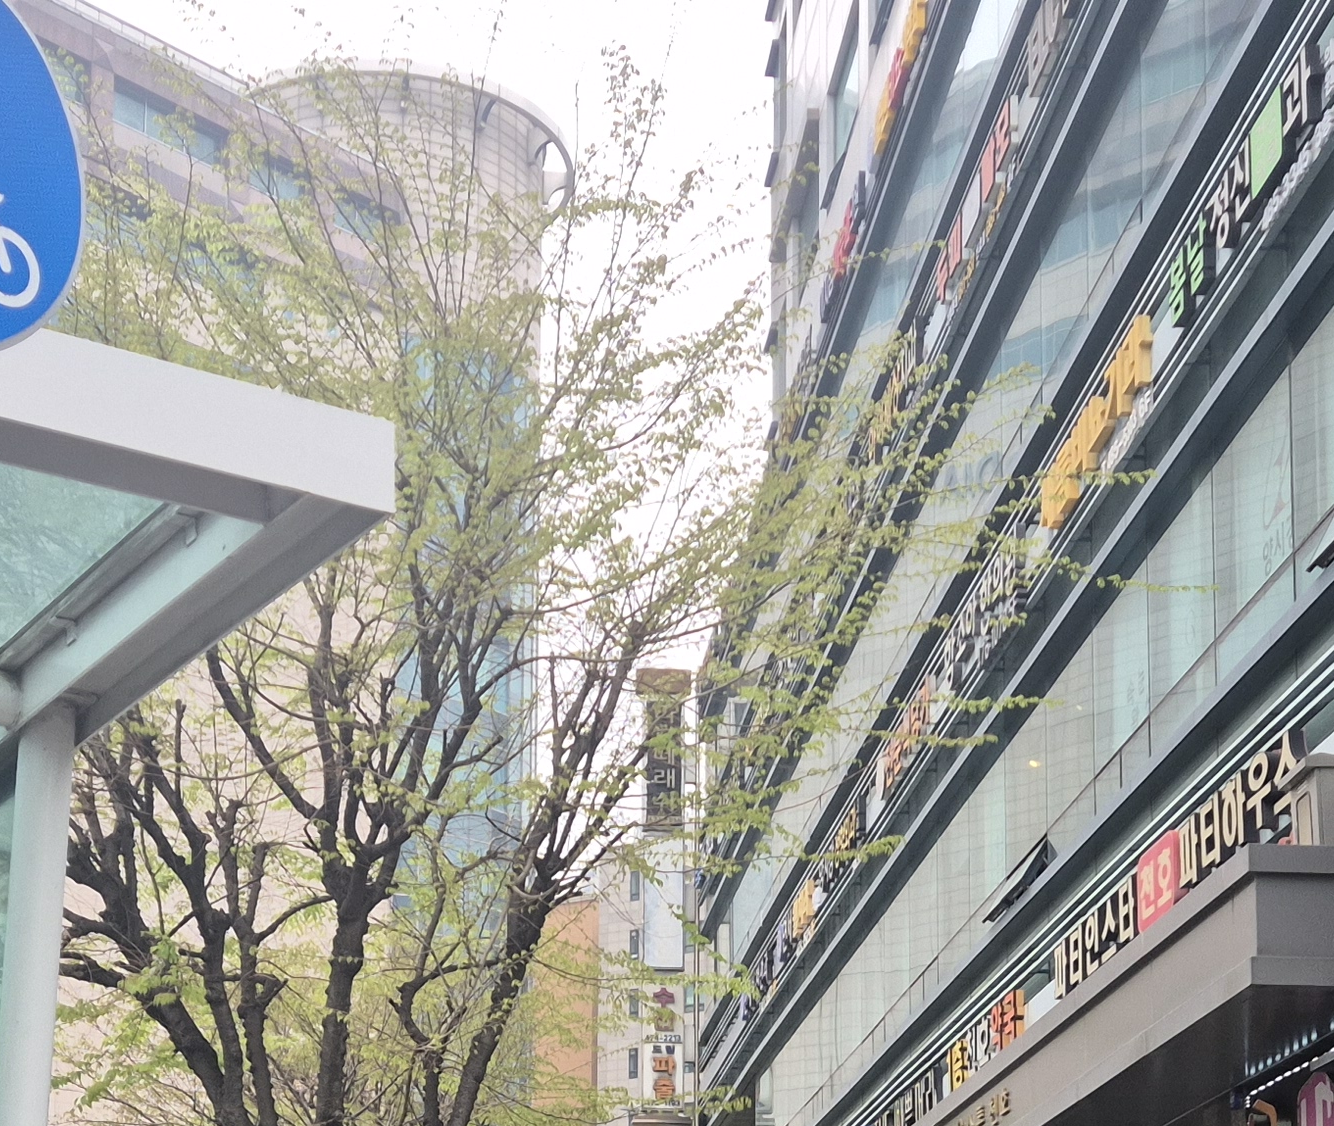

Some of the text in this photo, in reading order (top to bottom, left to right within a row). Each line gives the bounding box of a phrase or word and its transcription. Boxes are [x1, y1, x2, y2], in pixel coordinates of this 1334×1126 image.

[1169, 210, 1207, 328] 봄날
[1053, 731, 1301, 999] 파티인스타 천호 파티하우스
